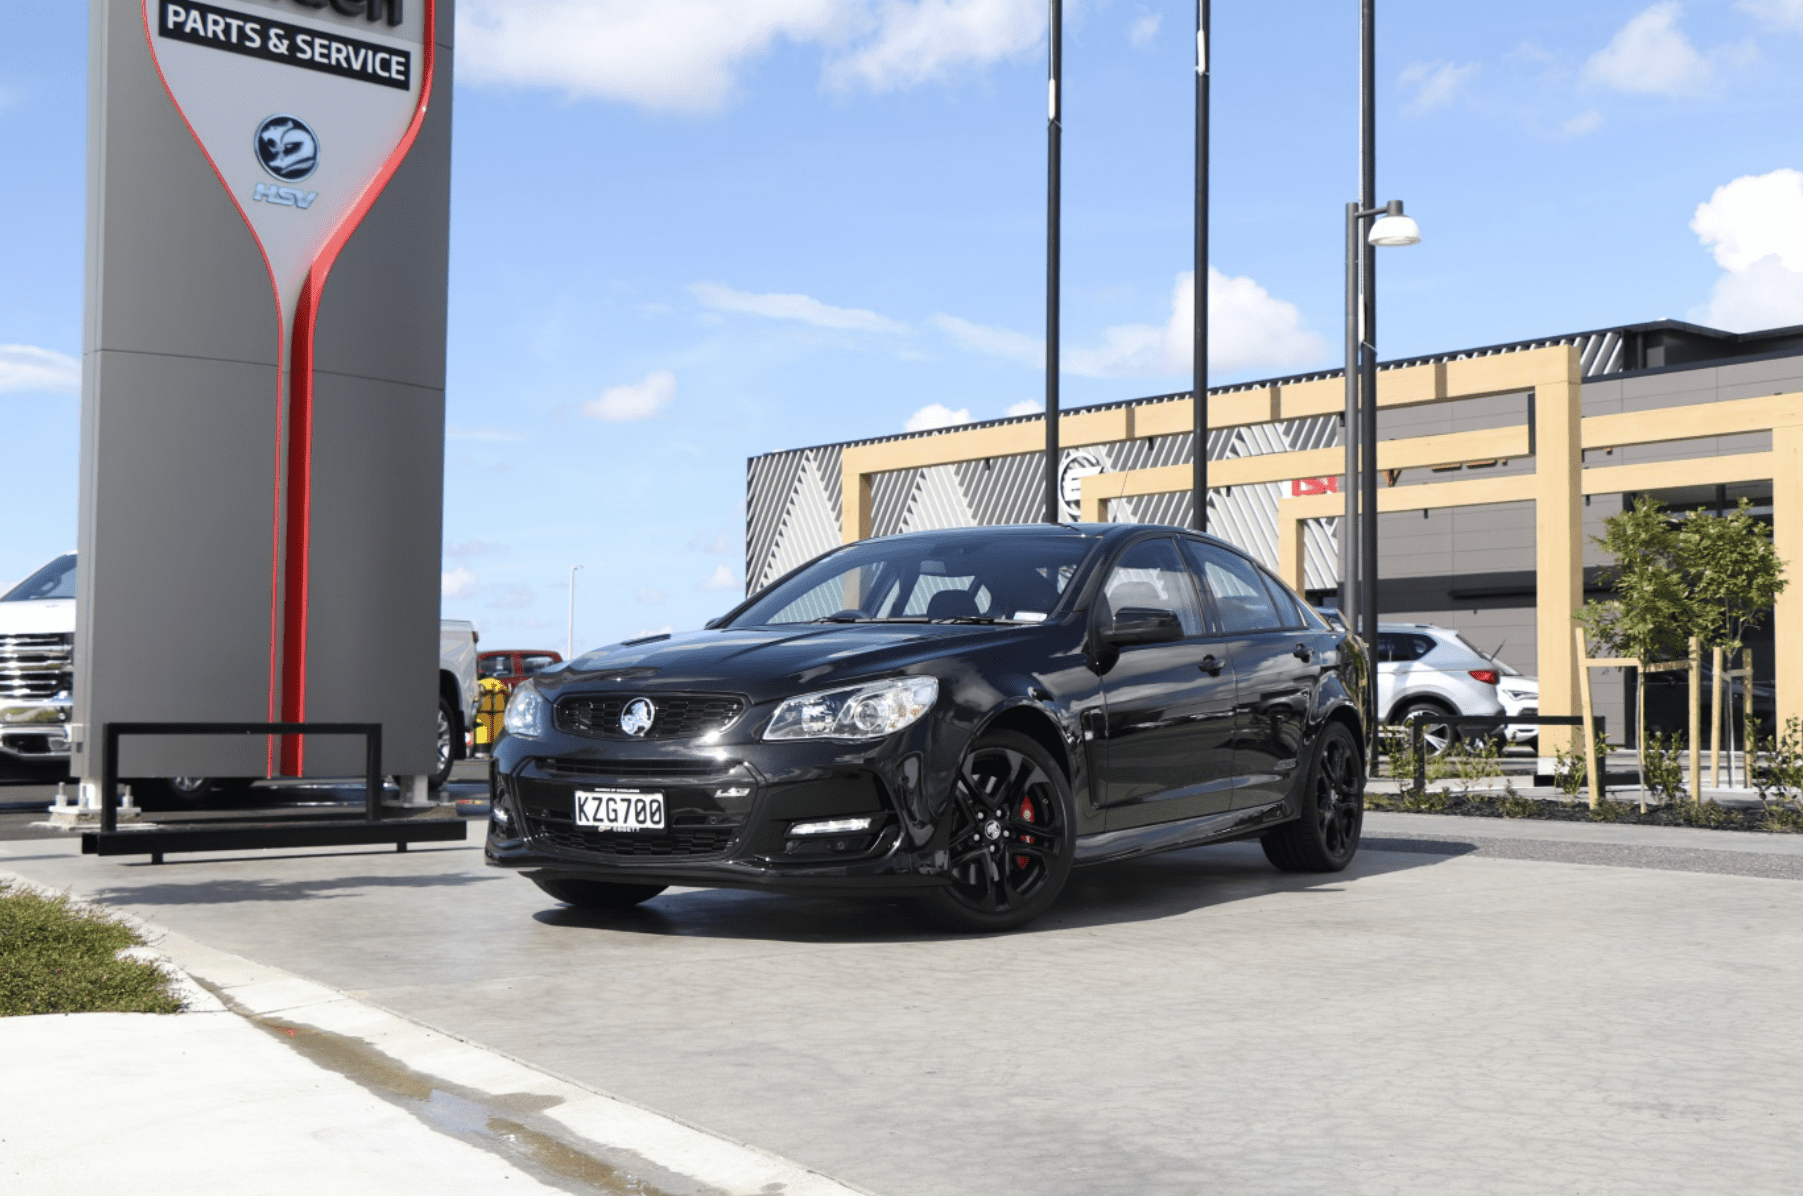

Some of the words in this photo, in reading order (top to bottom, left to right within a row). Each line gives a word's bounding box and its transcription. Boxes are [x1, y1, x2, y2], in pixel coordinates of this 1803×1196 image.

[167, 4, 262, 48] PARTS
[267, 28, 290, 55] &
[295, 34, 406, 80] SERVICE
[253, 182, 319, 210] HSV
[577, 796, 663, 825] KZG700
